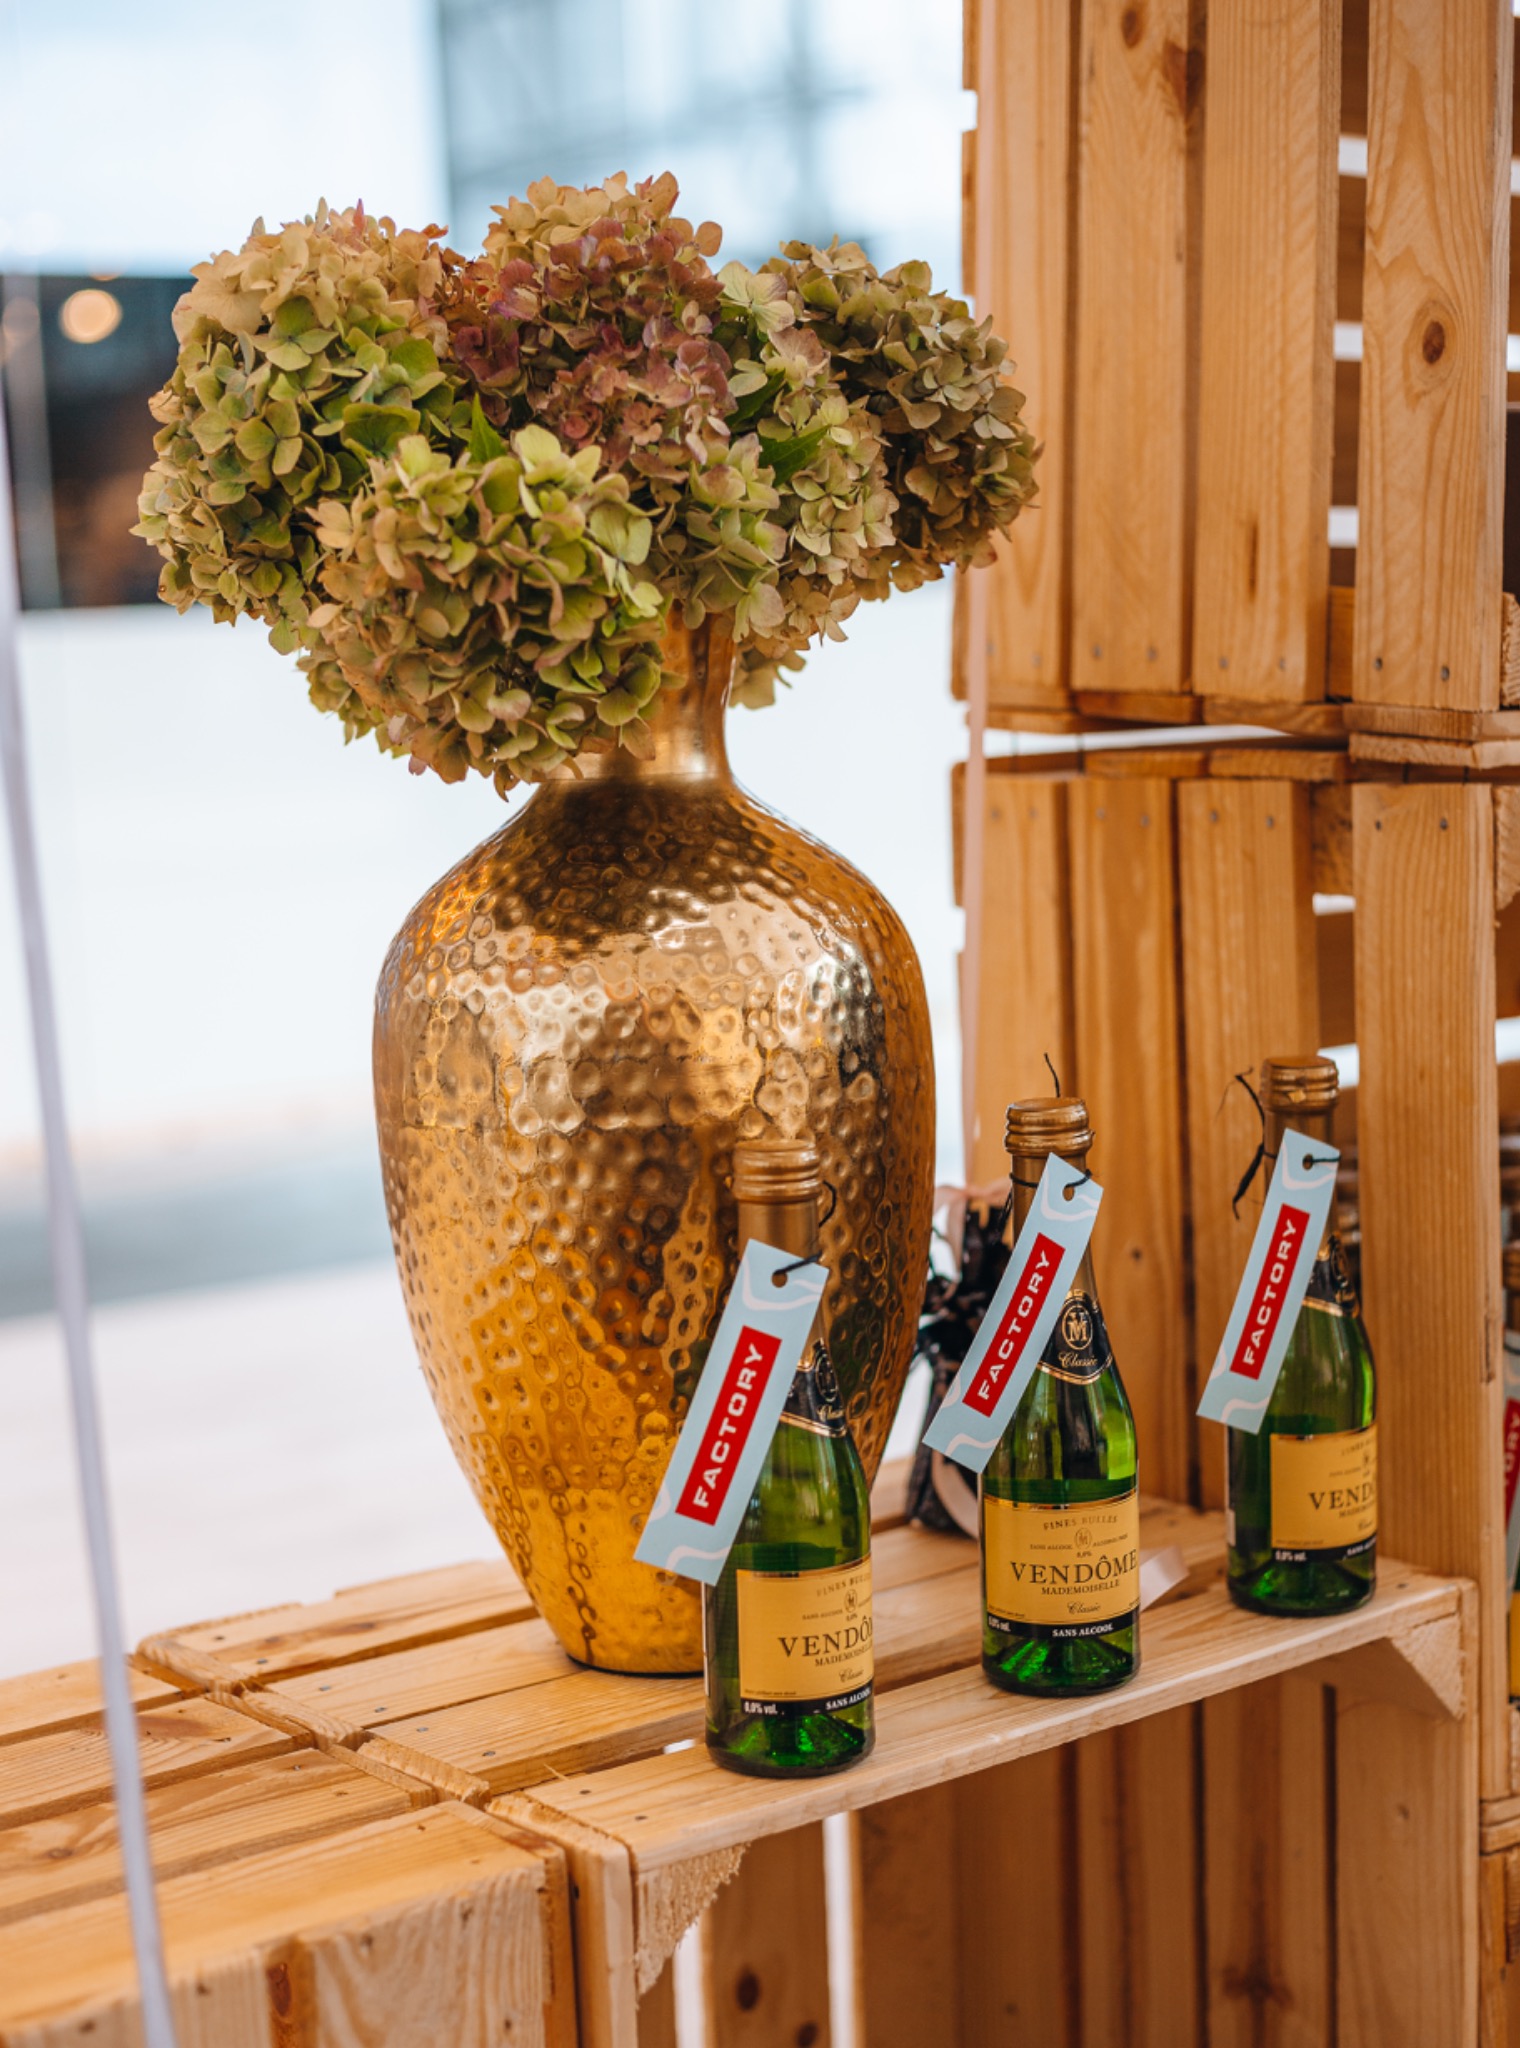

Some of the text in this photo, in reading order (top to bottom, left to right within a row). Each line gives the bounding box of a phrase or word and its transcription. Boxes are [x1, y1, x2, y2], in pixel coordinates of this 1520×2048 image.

[1243, 1218, 1297, 1366] FACTORY
[977, 1249, 1051, 1401] FACTORY
[1058, 1352, 1098, 1368] Classic
[692, 1342, 764, 1508] FACTORY
[1308, 1481, 1374, 1511] VEND
[1010, 1548, 1137, 1584] VENDÔME
[1041, 1579, 1120, 1596] MADEMOISELLE
[1052, 1623, 1113, 1637] SANS ALCOOL
[825, 1699, 848, 1711] SANS
